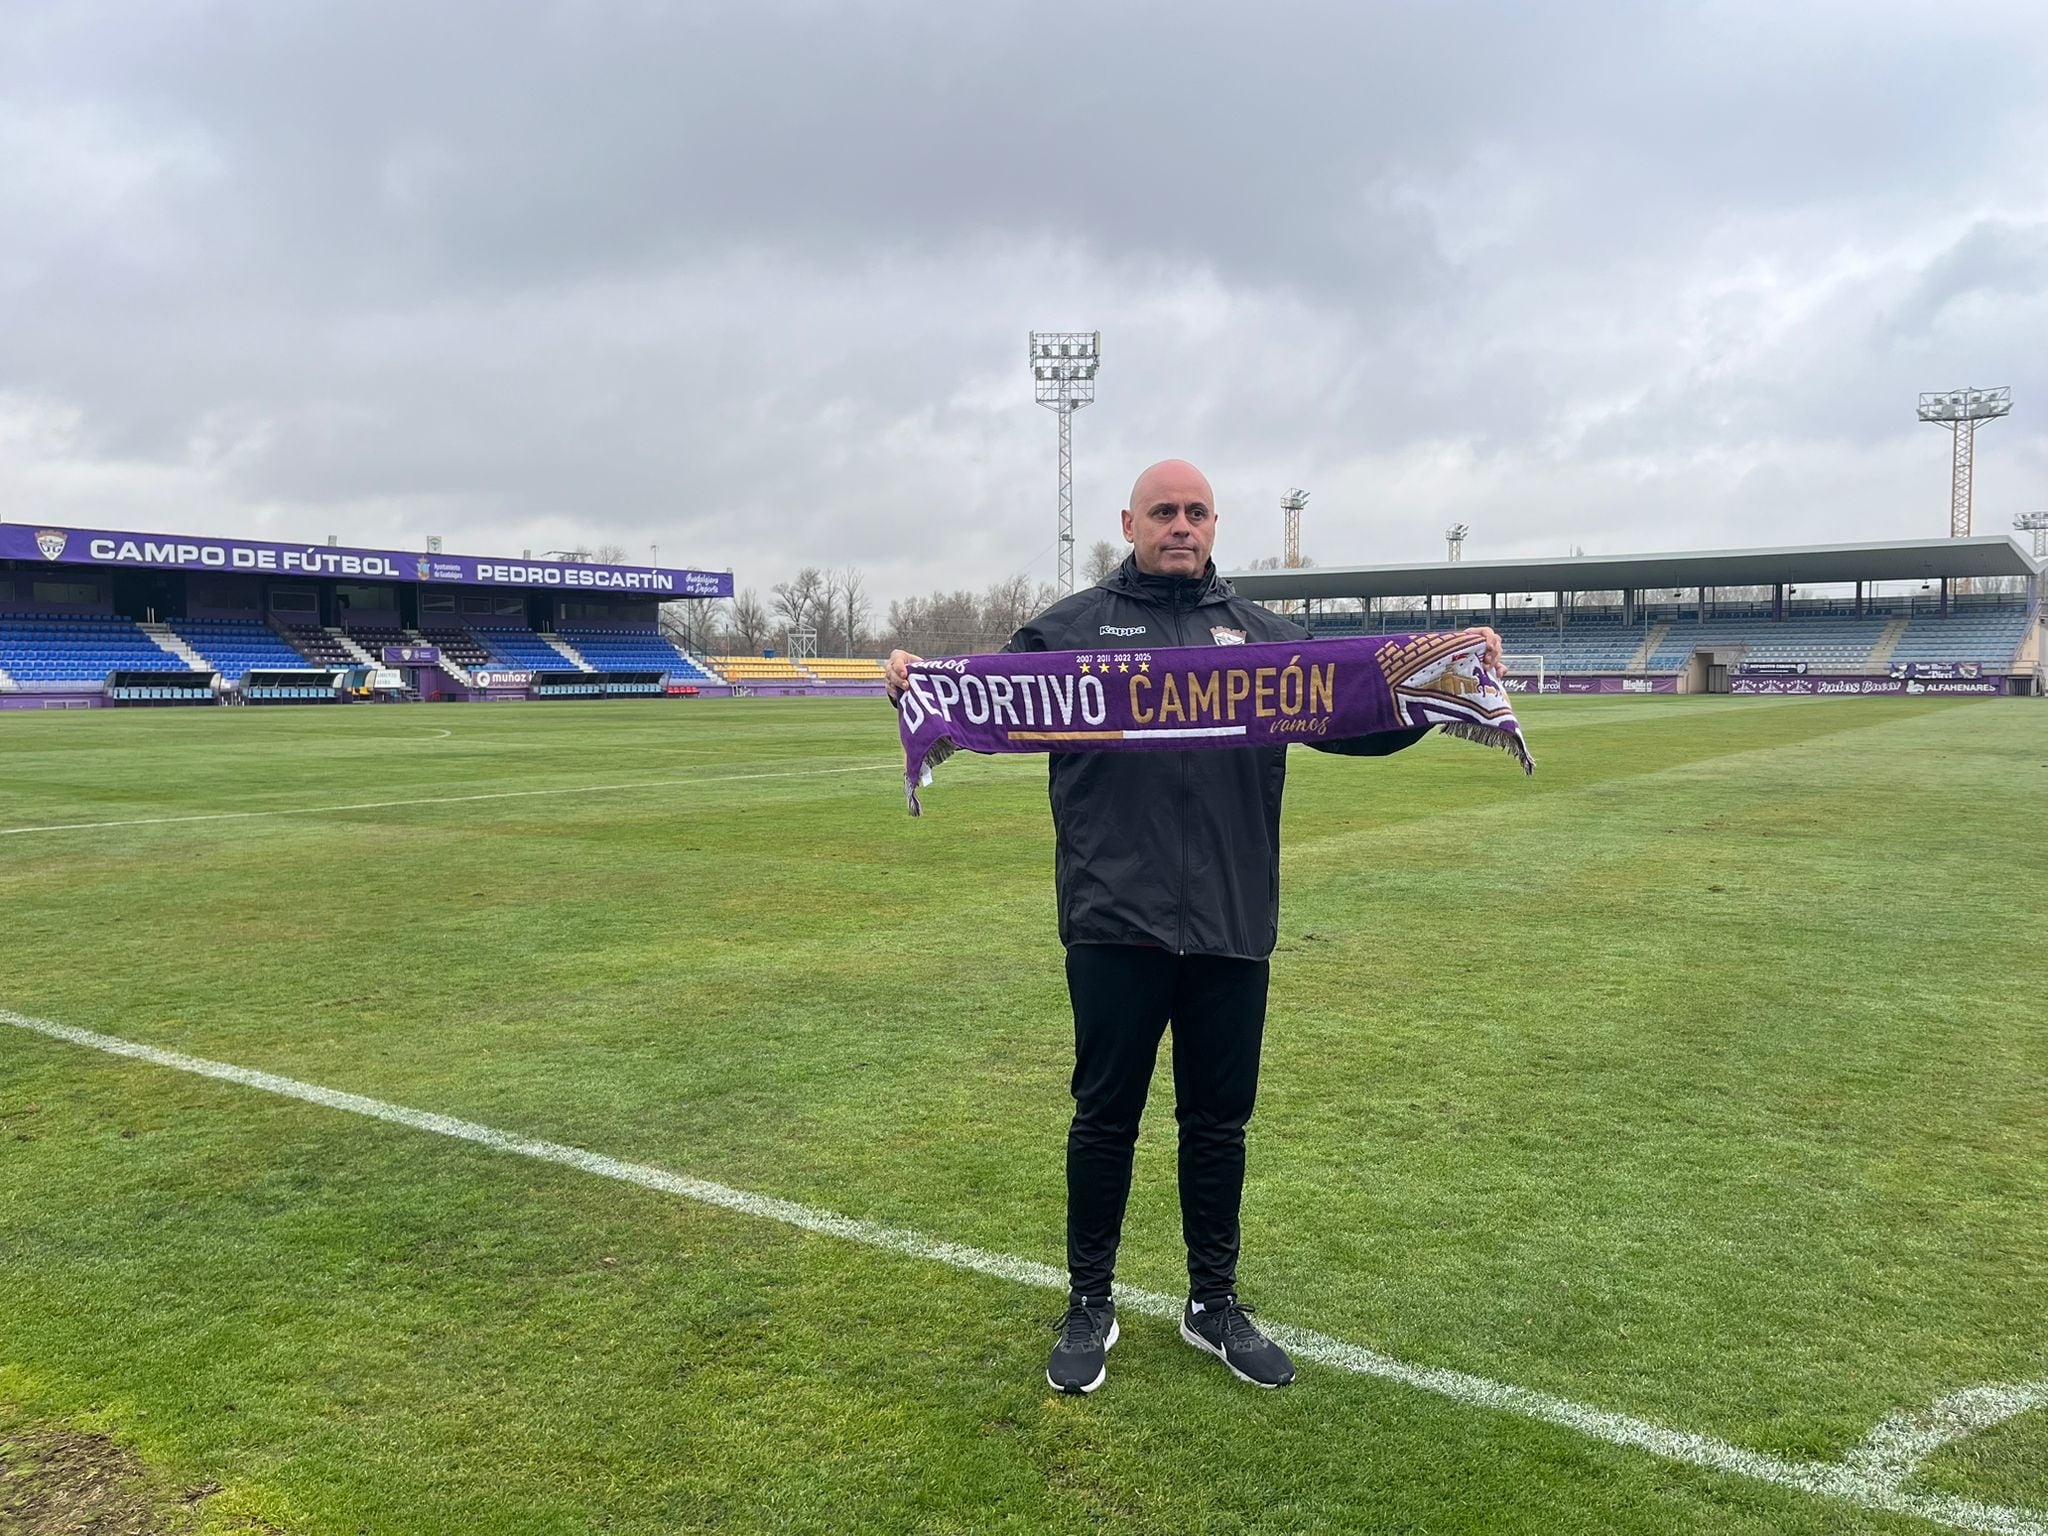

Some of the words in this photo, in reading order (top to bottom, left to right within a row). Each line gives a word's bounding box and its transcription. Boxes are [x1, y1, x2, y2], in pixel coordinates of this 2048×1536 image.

[90, 539, 225, 566] CAMPO
[232, 548, 277, 569] DE
[283, 547, 400, 577] FÚTBOL
[477, 564, 560, 585] PEDRO
[565, 570, 673, 590] ESCARTÍN
[686, 572, 719, 586] Guadalajara
[1099, 625, 1147, 637] Kappa
[1076, 654, 1094, 663] 2007
[1096, 654, 1111, 662] 2011
[1113, 653, 1131, 662] 2022
[1134, 652, 1152, 661] 2025
[492, 671, 527, 683] muñoz
[1927, 683, 1996, 692] ALFAHENARES
[900, 673, 1106, 735] DEPORTIVO
[1129, 655, 1336, 724] CAMPEÓN
[1270, 716, 1330, 736] vamos
